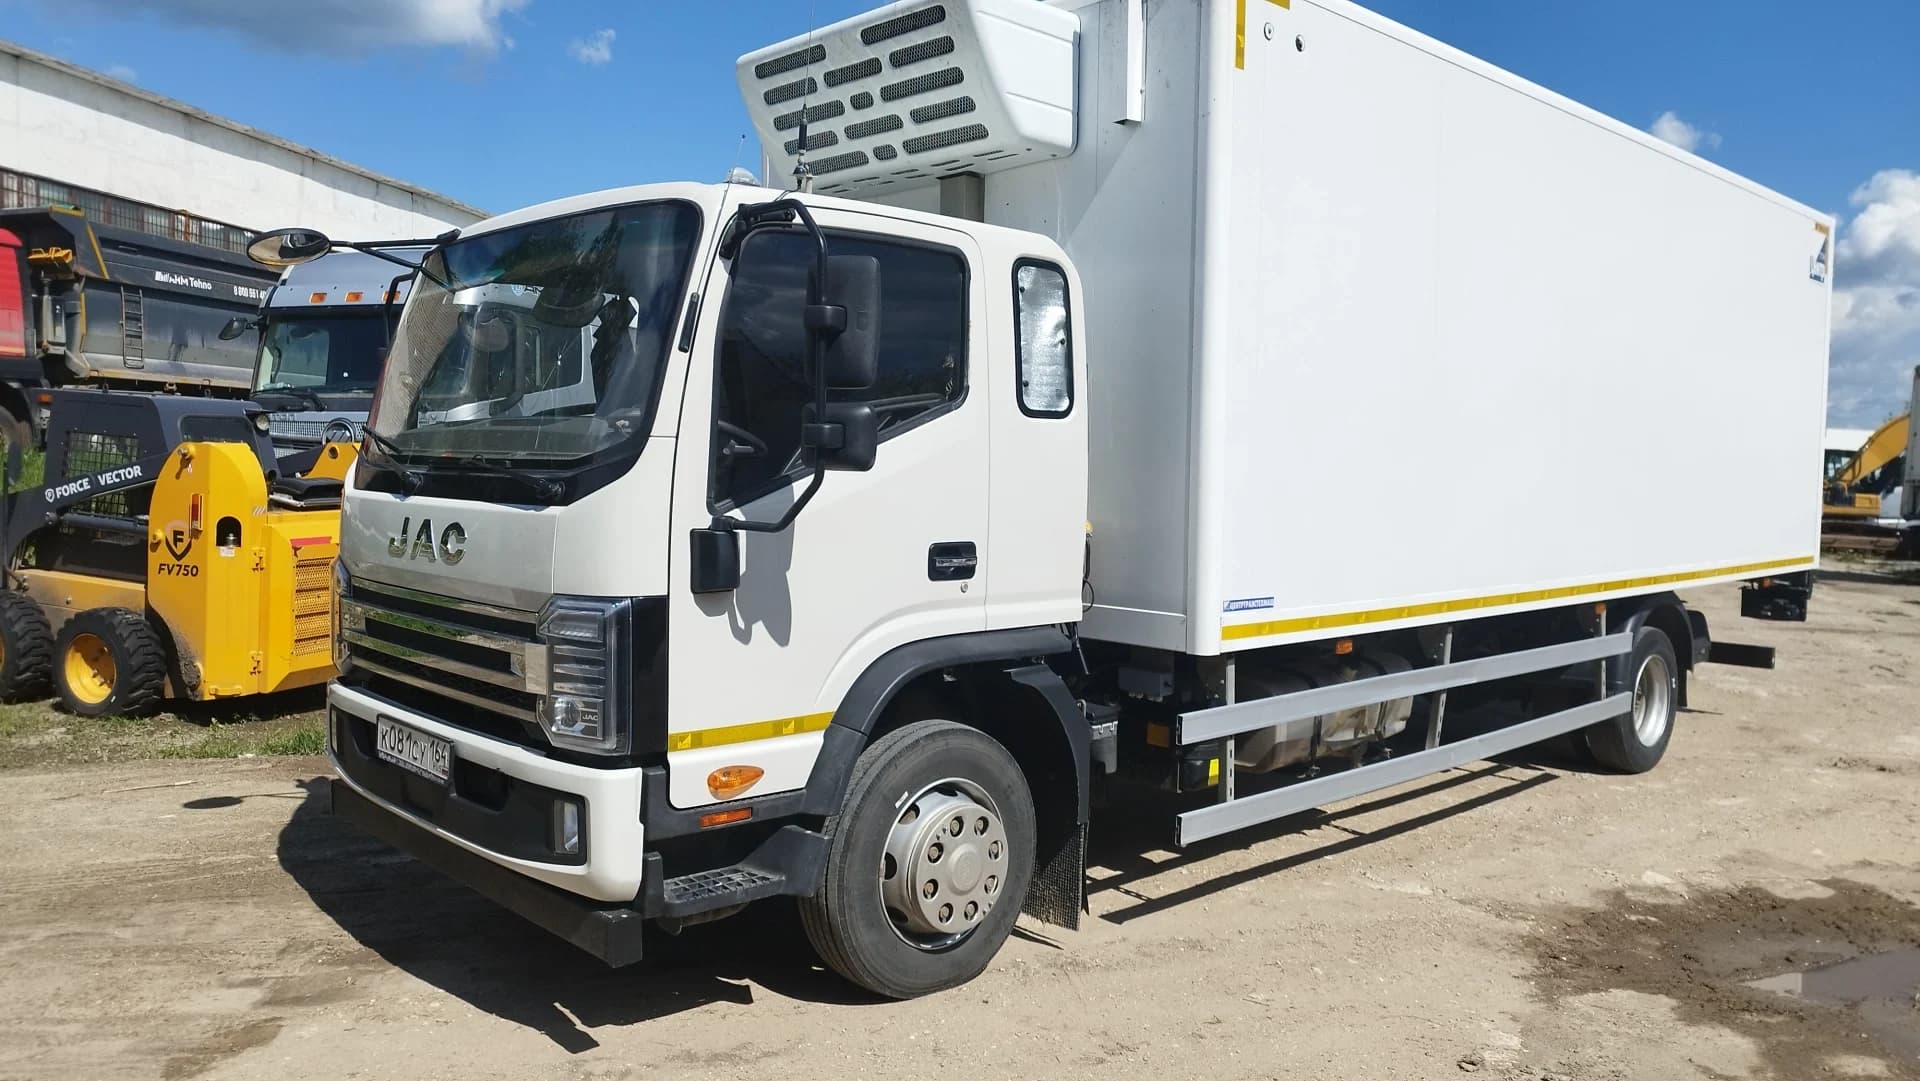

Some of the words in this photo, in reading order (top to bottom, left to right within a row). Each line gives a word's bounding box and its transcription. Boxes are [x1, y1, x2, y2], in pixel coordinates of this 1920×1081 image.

[55, 478, 91, 499] FORCE
[97, 465, 143, 486] VECTOR
[388, 516, 467, 566] JAC
[158, 563, 199, 577] FV750
[429, 740, 448, 769] 164
